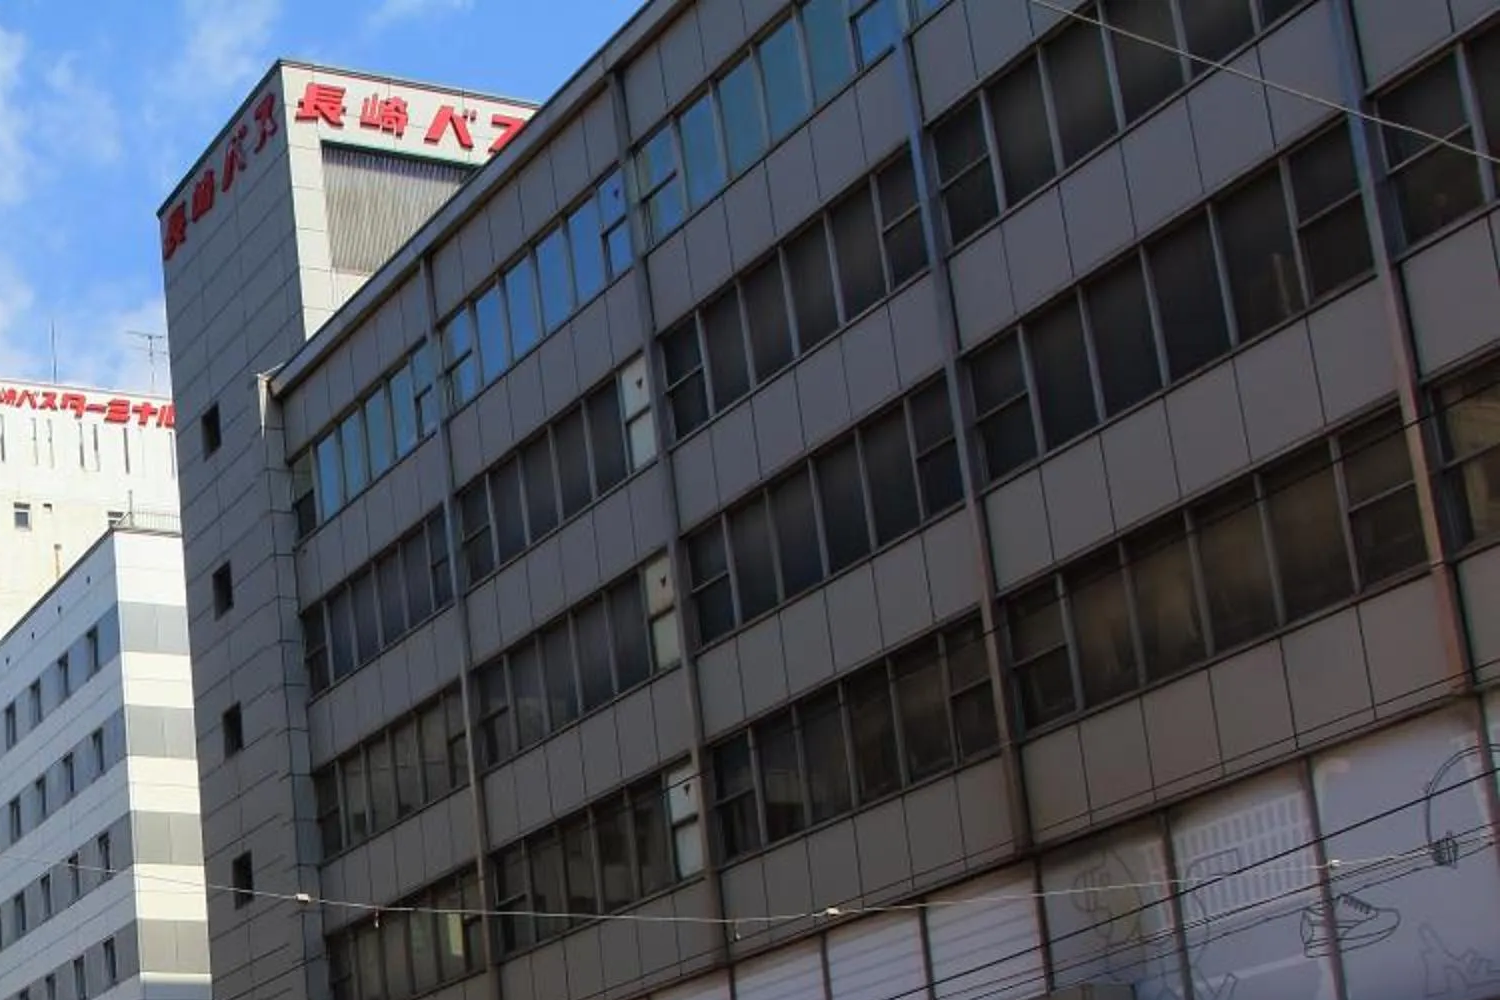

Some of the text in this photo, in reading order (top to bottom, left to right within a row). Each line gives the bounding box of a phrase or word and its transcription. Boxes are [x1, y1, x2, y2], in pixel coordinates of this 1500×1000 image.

[163, 91, 277, 261] 長崎バス
[295, 82, 526, 155] 長崎バス
